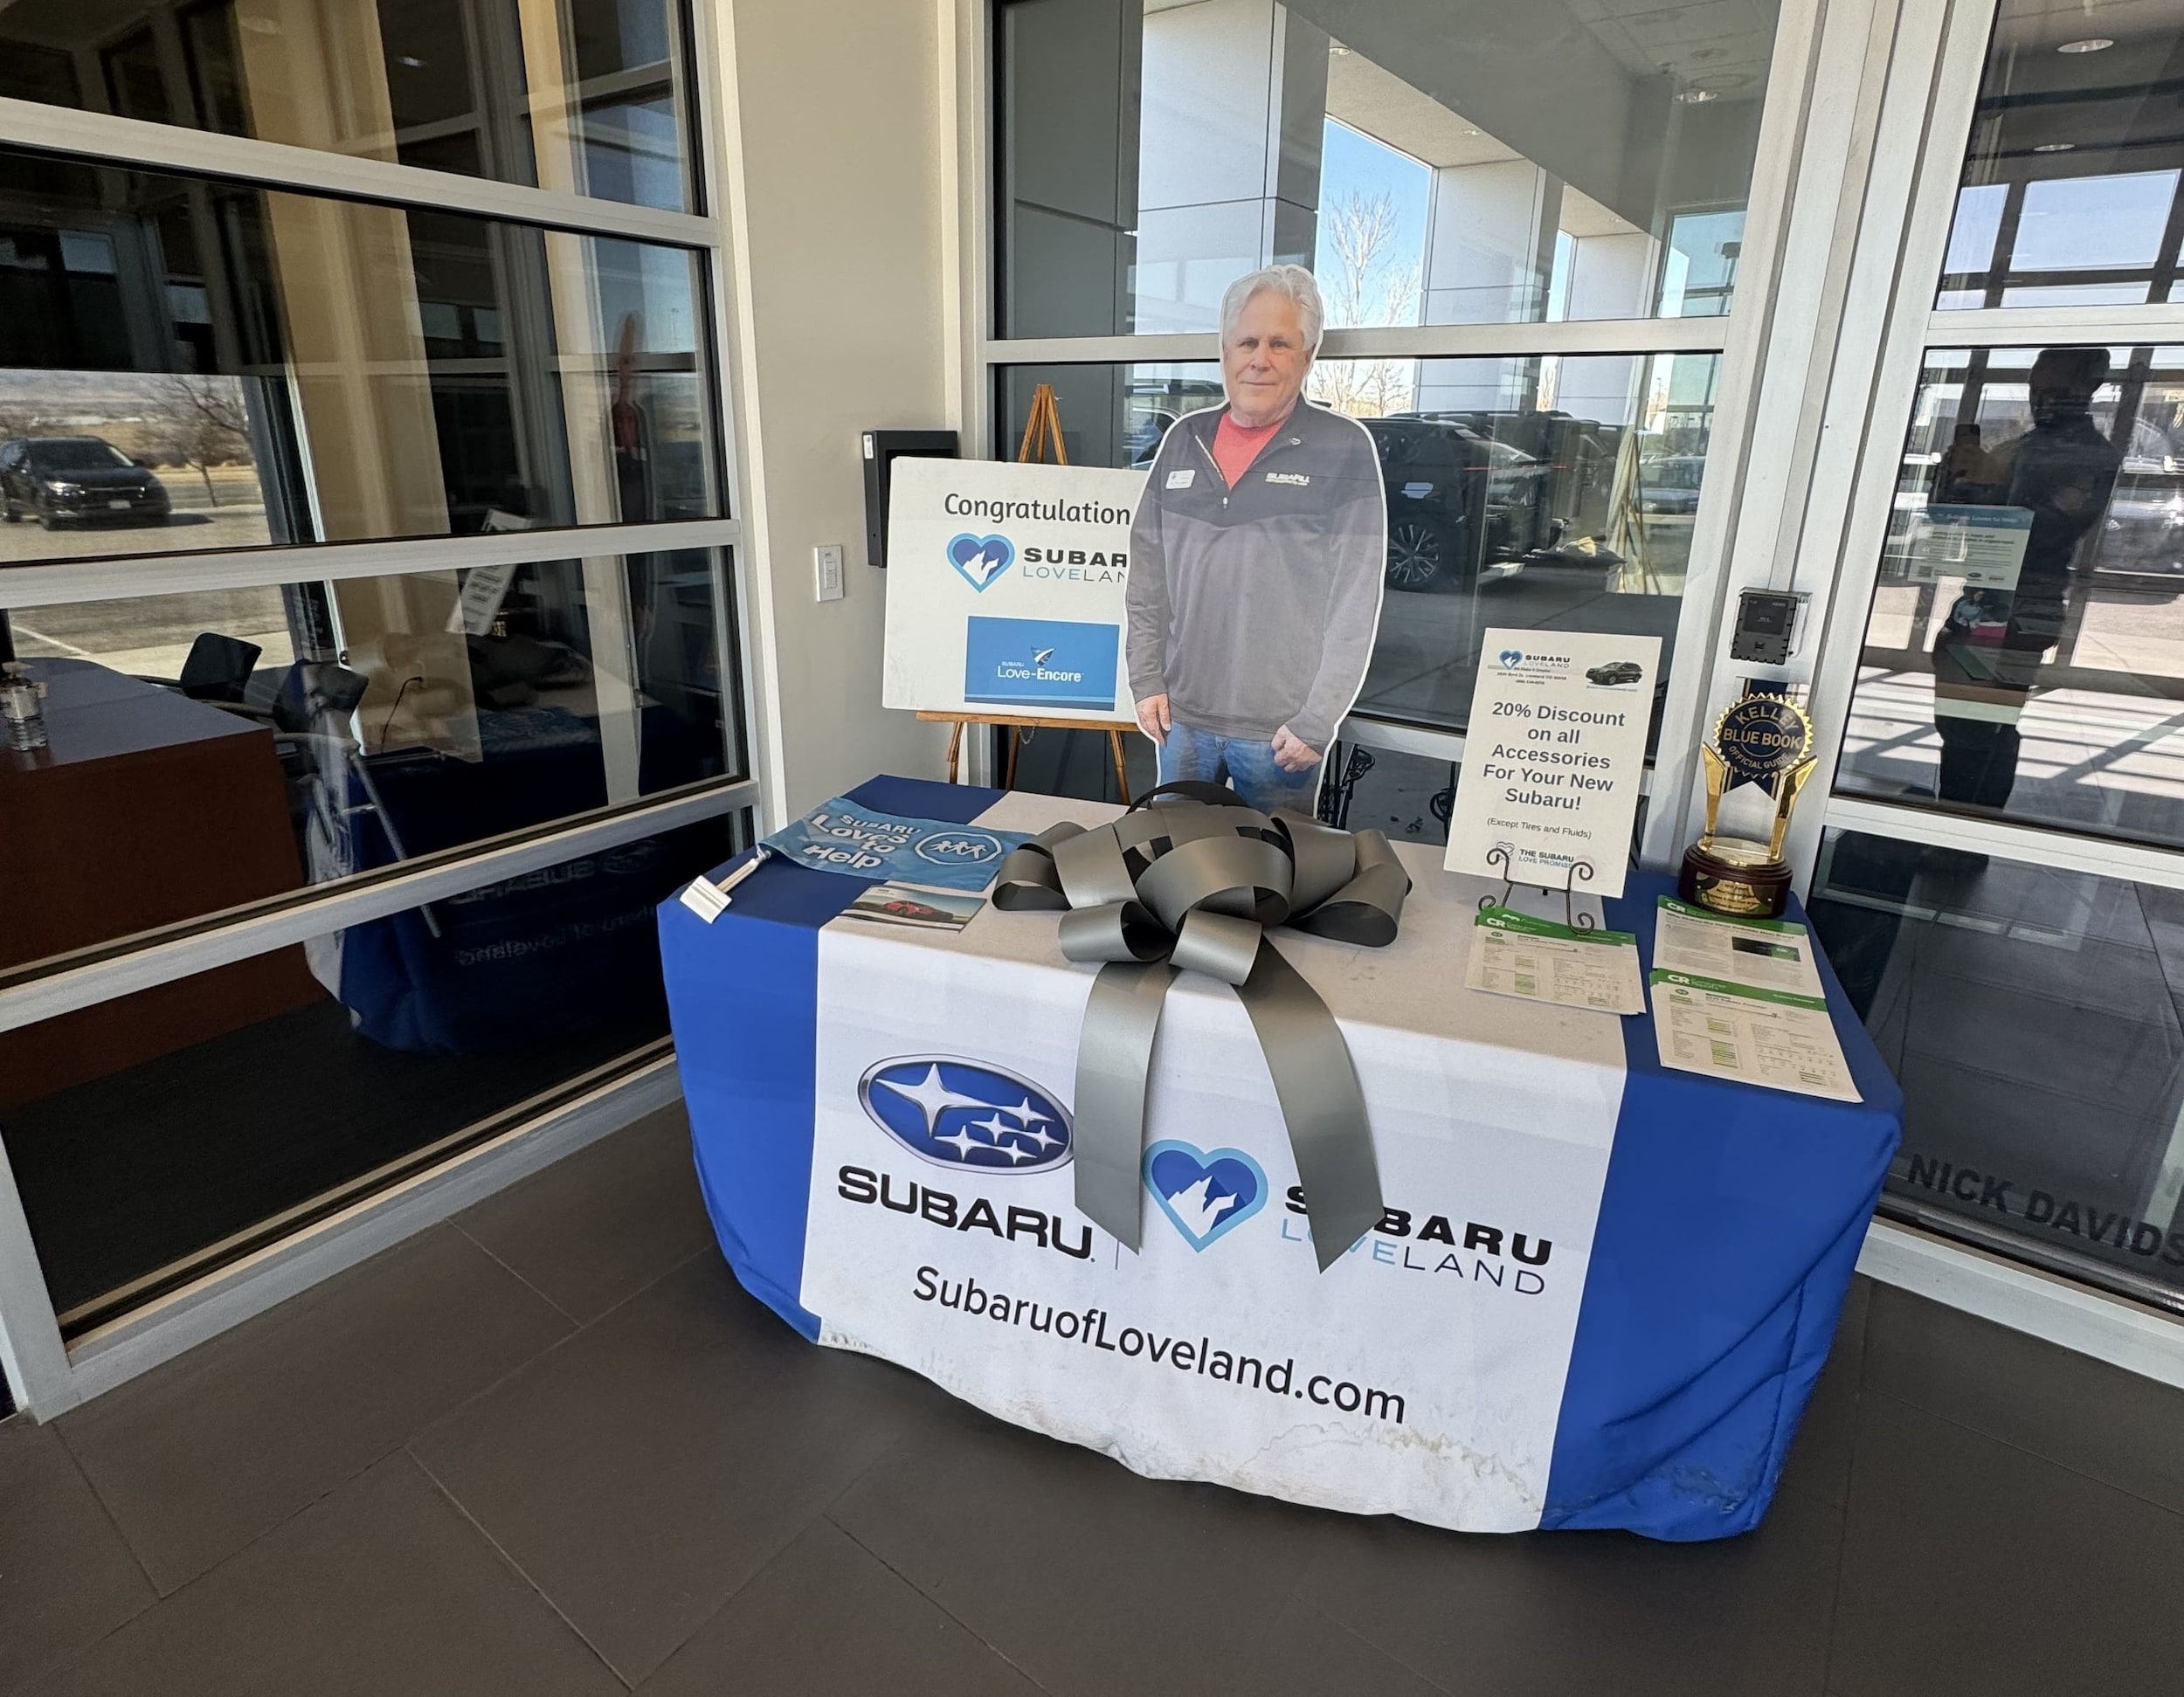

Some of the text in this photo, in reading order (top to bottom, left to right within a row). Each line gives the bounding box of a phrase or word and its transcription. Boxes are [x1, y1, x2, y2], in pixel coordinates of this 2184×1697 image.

[944, 493, 1130, 525] Congratulation
[1023, 547, 1127, 568] SUBAR
[1023, 565, 1125, 583] LOVELAN
[1524, 654, 1571, 663] SUBARU
[997, 665, 1082, 682] Love-Encore
[1492, 701, 1626, 727] 20% Discount
[1735, 705, 1800, 730] KELLEY
[1527, 728, 1580, 744] on all
[1723, 728, 1803, 749] BLUE BOOK
[1491, 743, 1611, 769] Accessories
[1728, 745, 1791, 769] OFFICIAL GUIDE
[1482, 763, 1614, 792] For Your New
[1504, 788, 1581, 811] Subaru!
[811, 813, 910, 844] Loves
[840, 814, 922, 834] SUBARU
[1487, 817, 1592, 839] (Except Tires and Fluids)
[802, 845, 882, 869] Help
[860, 840, 896, 853] to
[1519, 848, 1574, 863] THE SUBARU
[1518, 855, 1538, 864] LOVE
[1486, 917, 1506, 928] CR
[1667, 974, 1690, 985] CR
[1908, 1153, 2013, 1213] NICK
[837, 1164, 1094, 1260] SUBARU
[1284, 1186, 1552, 1266] SBARU
[1281, 1218, 1545, 1295] LELAND
[912, 1265, 1406, 1424] SubaruofLoveland.com
